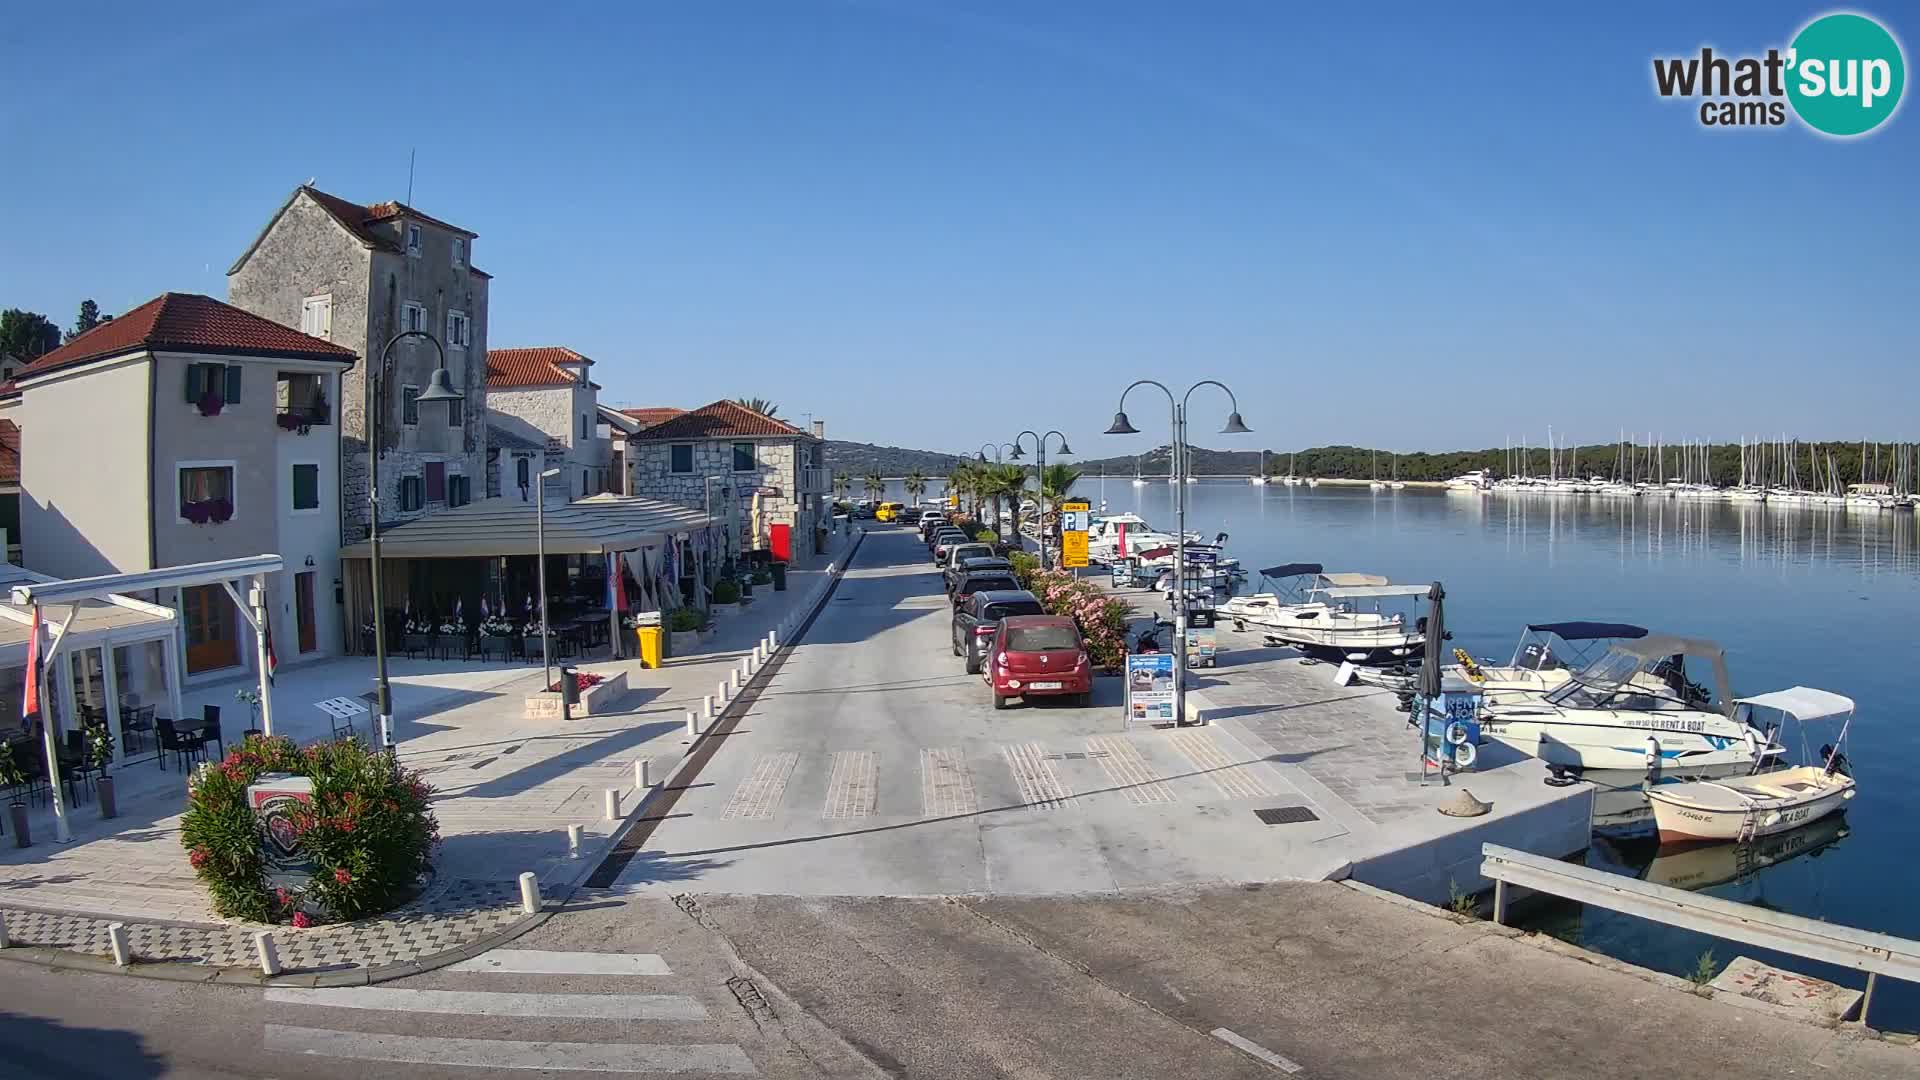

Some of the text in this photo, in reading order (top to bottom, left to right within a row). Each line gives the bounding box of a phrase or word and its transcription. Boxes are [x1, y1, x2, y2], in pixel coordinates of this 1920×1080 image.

[1447, 697, 1479, 709] RENT
[1660, 720, 1680, 729] RENT
[1680, 721, 1686, 730] A
[1687, 721, 1705, 732] BOAT
[1794, 807, 1810, 821] BOAT
